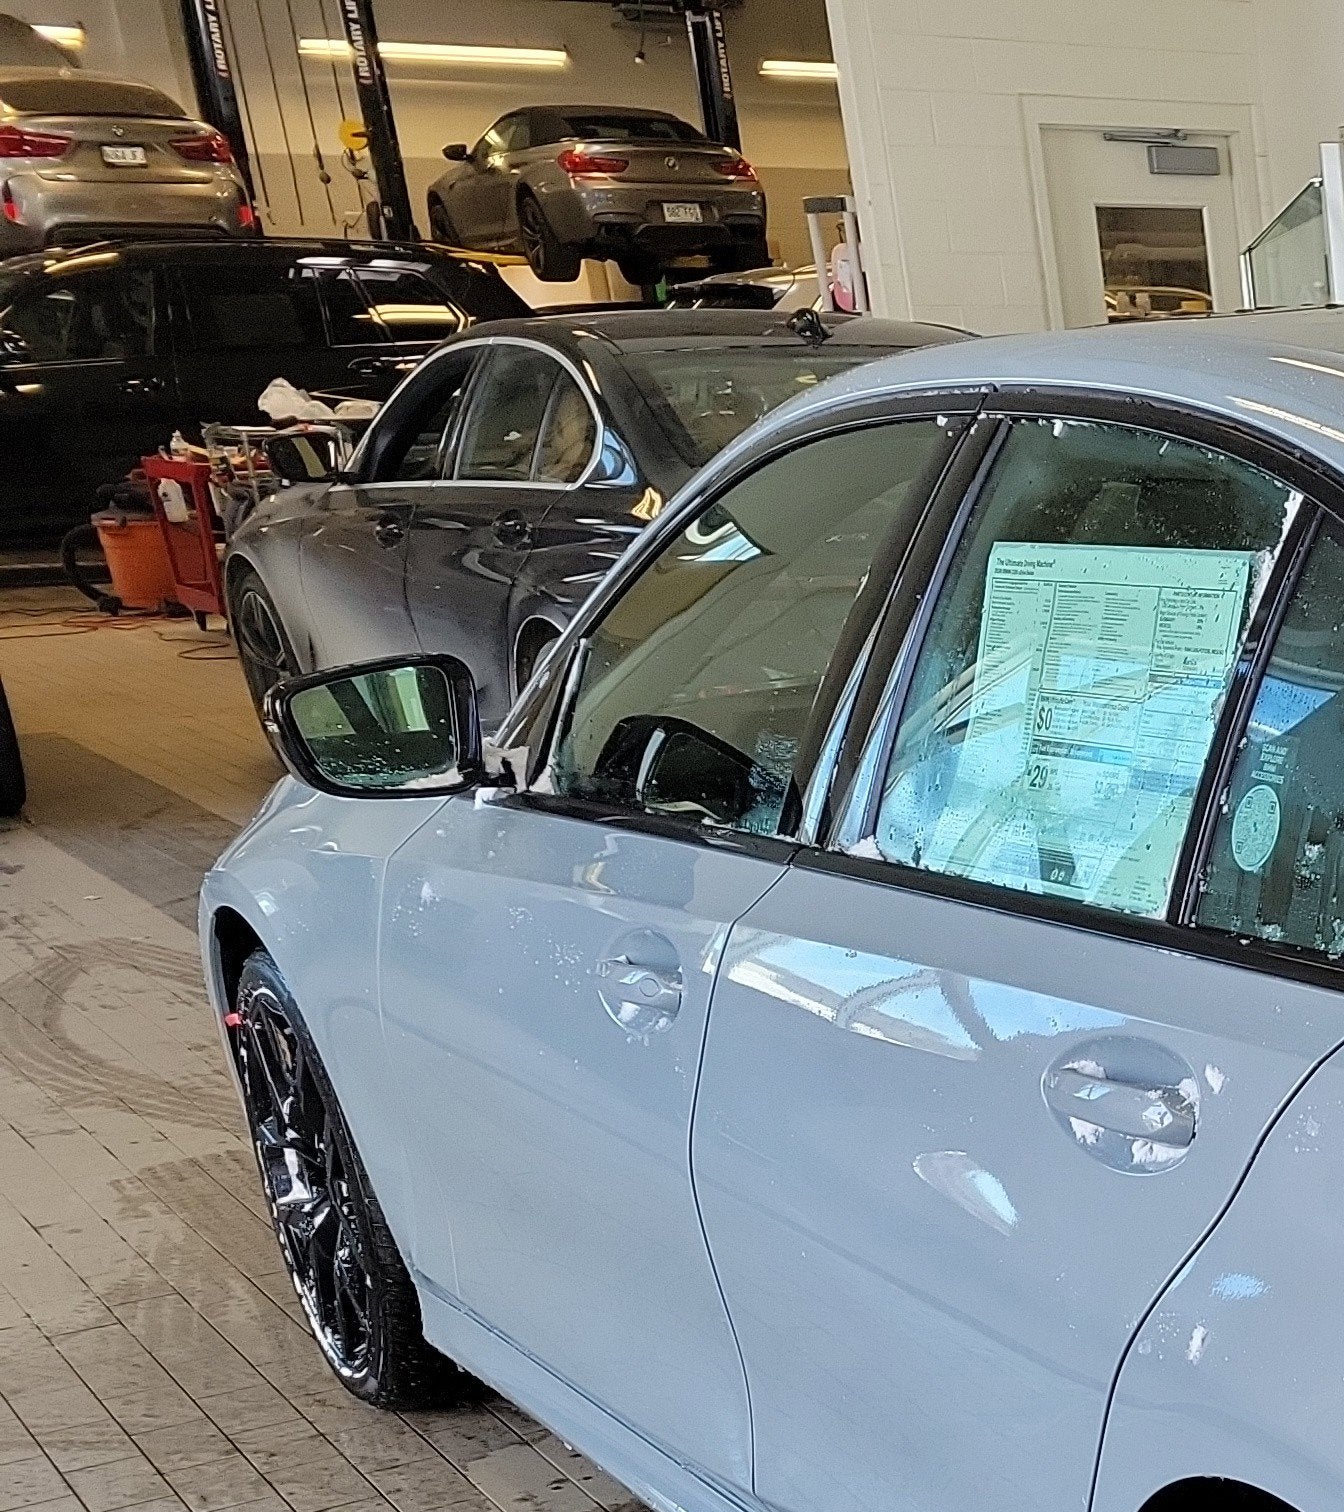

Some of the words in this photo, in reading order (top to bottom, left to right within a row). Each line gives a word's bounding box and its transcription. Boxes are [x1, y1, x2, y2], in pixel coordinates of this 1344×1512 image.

[206, 12, 228, 71] ROTARY
[713, 10, 723, 37] LIFT
[348, 21, 372, 77] ROTARY
[717, 40, 731, 92] ROTARY
[1037, 706, 1053, 732] $0
[1029, 764, 1049, 789] 29
